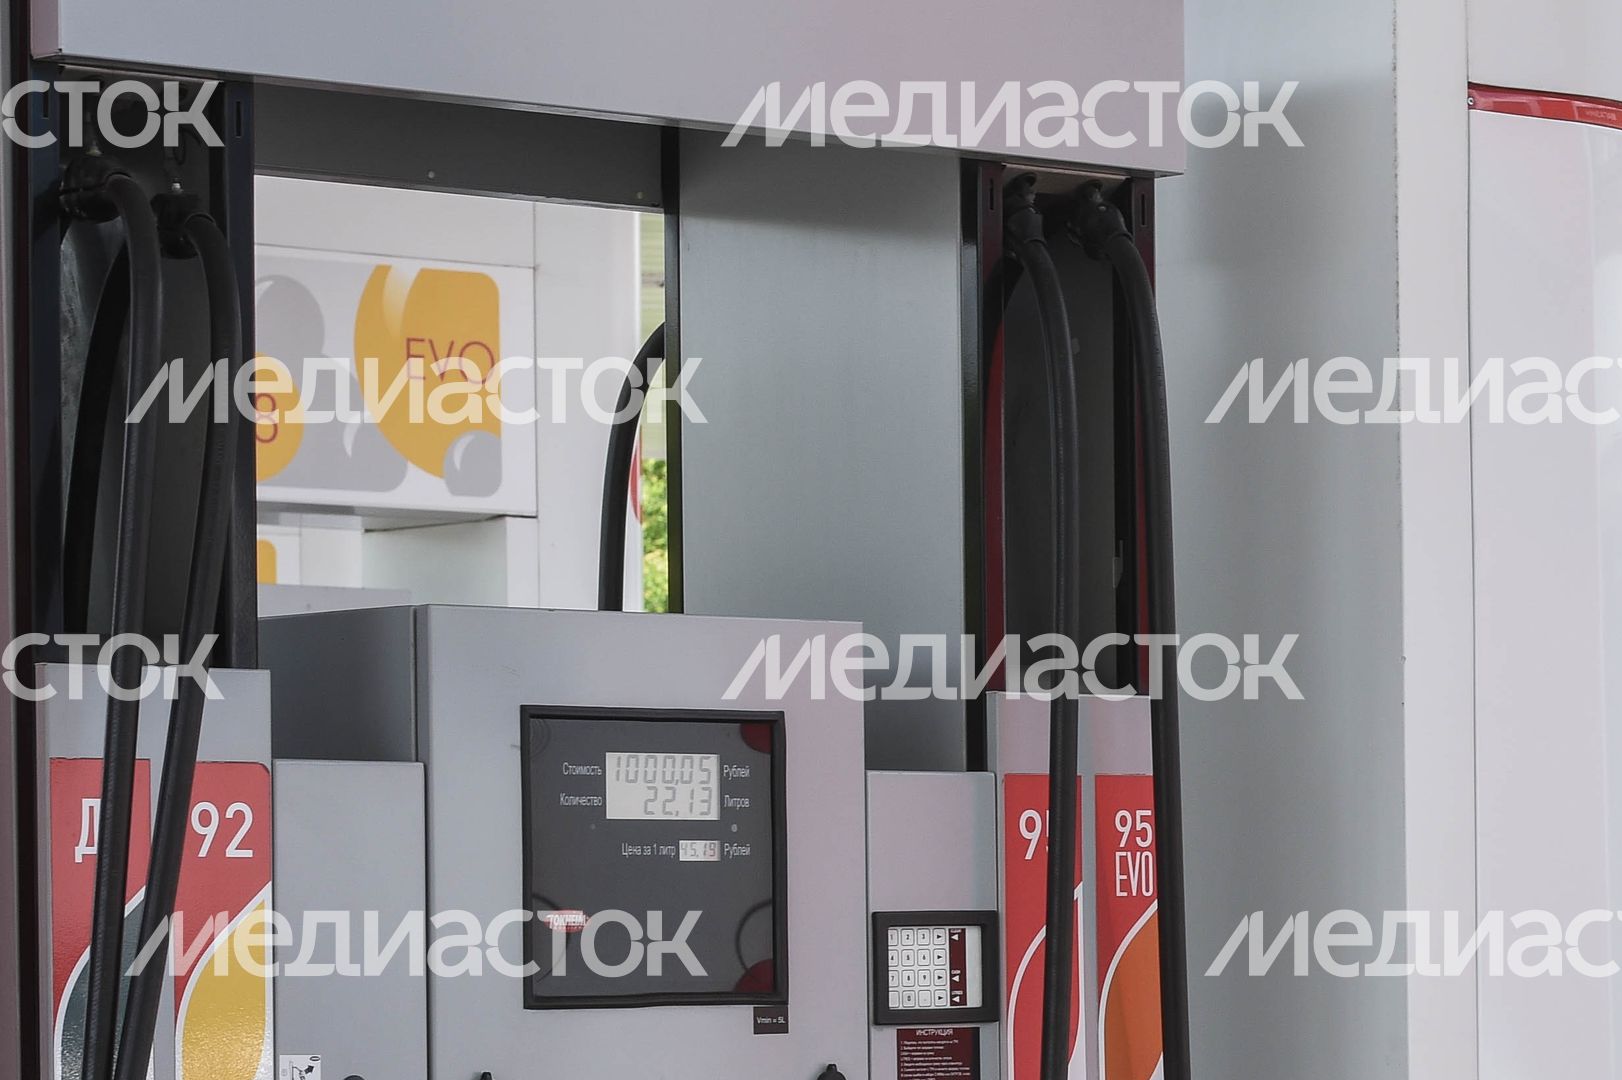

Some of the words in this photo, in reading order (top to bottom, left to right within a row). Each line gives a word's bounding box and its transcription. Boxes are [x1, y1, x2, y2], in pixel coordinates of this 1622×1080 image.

[405, 337, 496, 385] EVO
[562, 762, 602, 776] Стоимость
[723, 764, 750, 781] Рублей
[560, 792, 602, 807] Количество
[723, 794, 750, 808] Литров
[74, 797, 102, 864] Д
[190, 801, 254, 858] 92
[1018, 809, 1050, 861] 9
[1114, 809, 1153, 849] 95
[622, 843, 643, 857] Цена
[644, 846, 652, 856] за
[658, 847, 676, 860] литр
[723, 843, 750, 859] Рублей
[1115, 850, 1154, 897] EVO
[915, 1028, 954, 1036] ИНСТРУКЦИЯ
